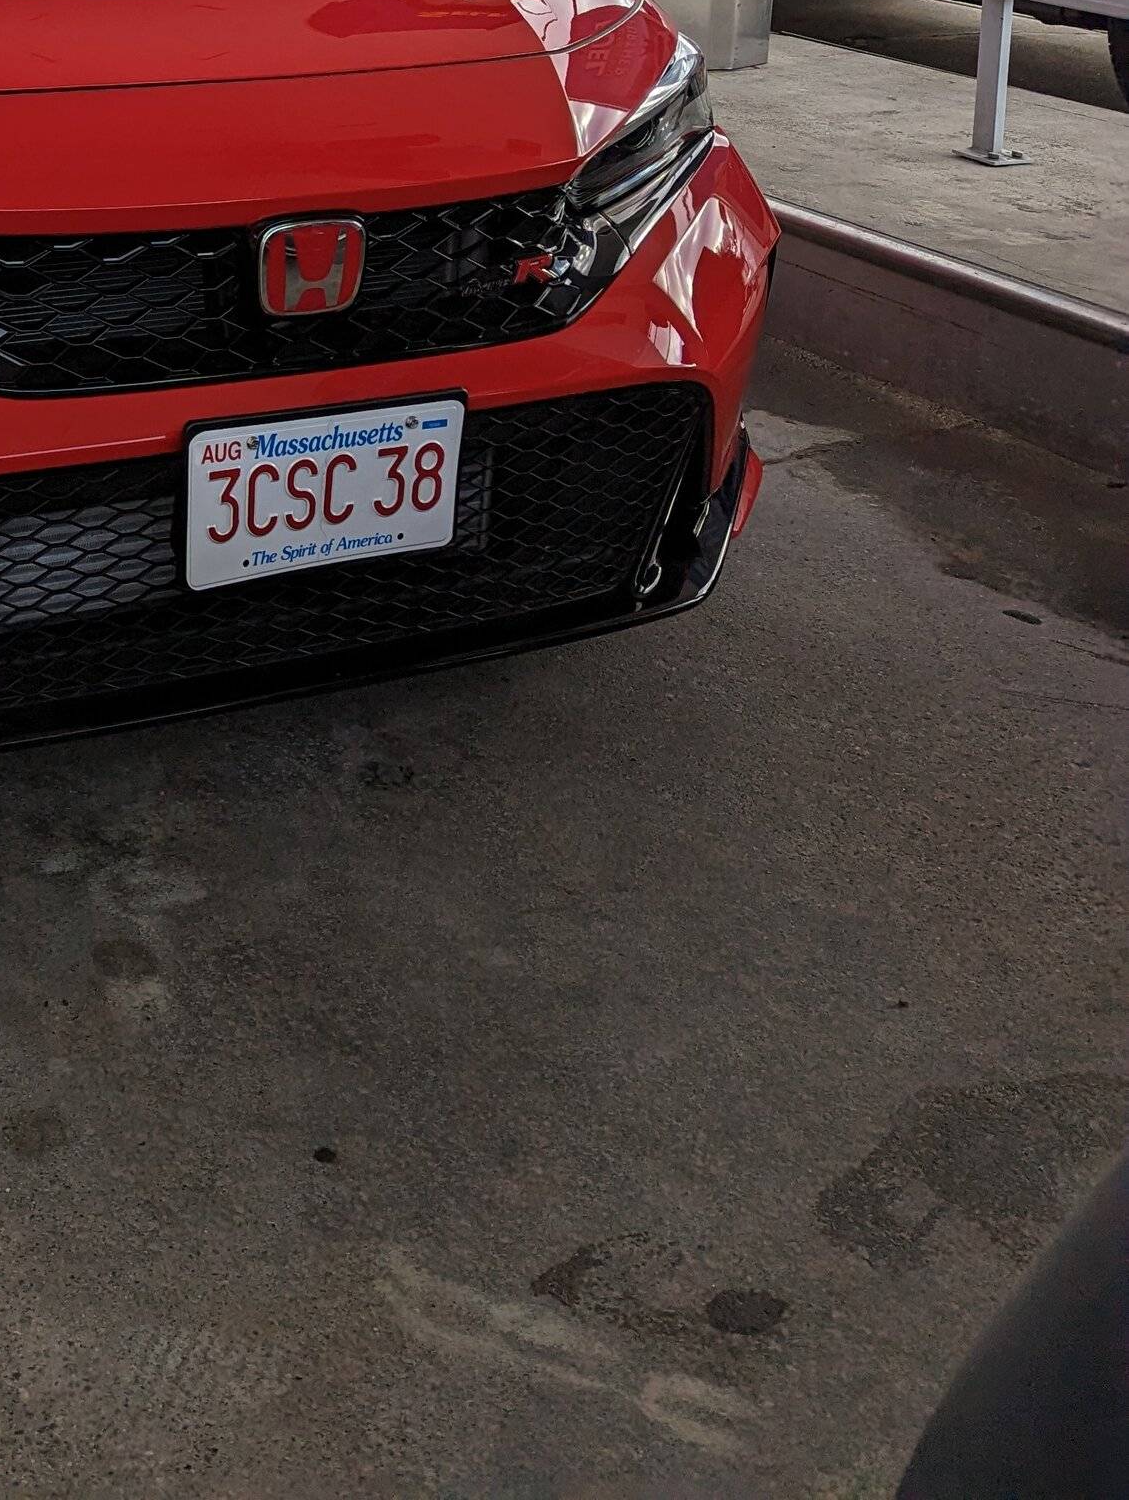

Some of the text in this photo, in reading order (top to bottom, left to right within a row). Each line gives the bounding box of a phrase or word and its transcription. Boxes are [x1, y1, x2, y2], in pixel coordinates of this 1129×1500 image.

[201, 422, 404, 464] AUG Massachusetts
[207, 442, 446, 543] 3CSC 38
[252, 534, 393, 567] The Spirit of America
